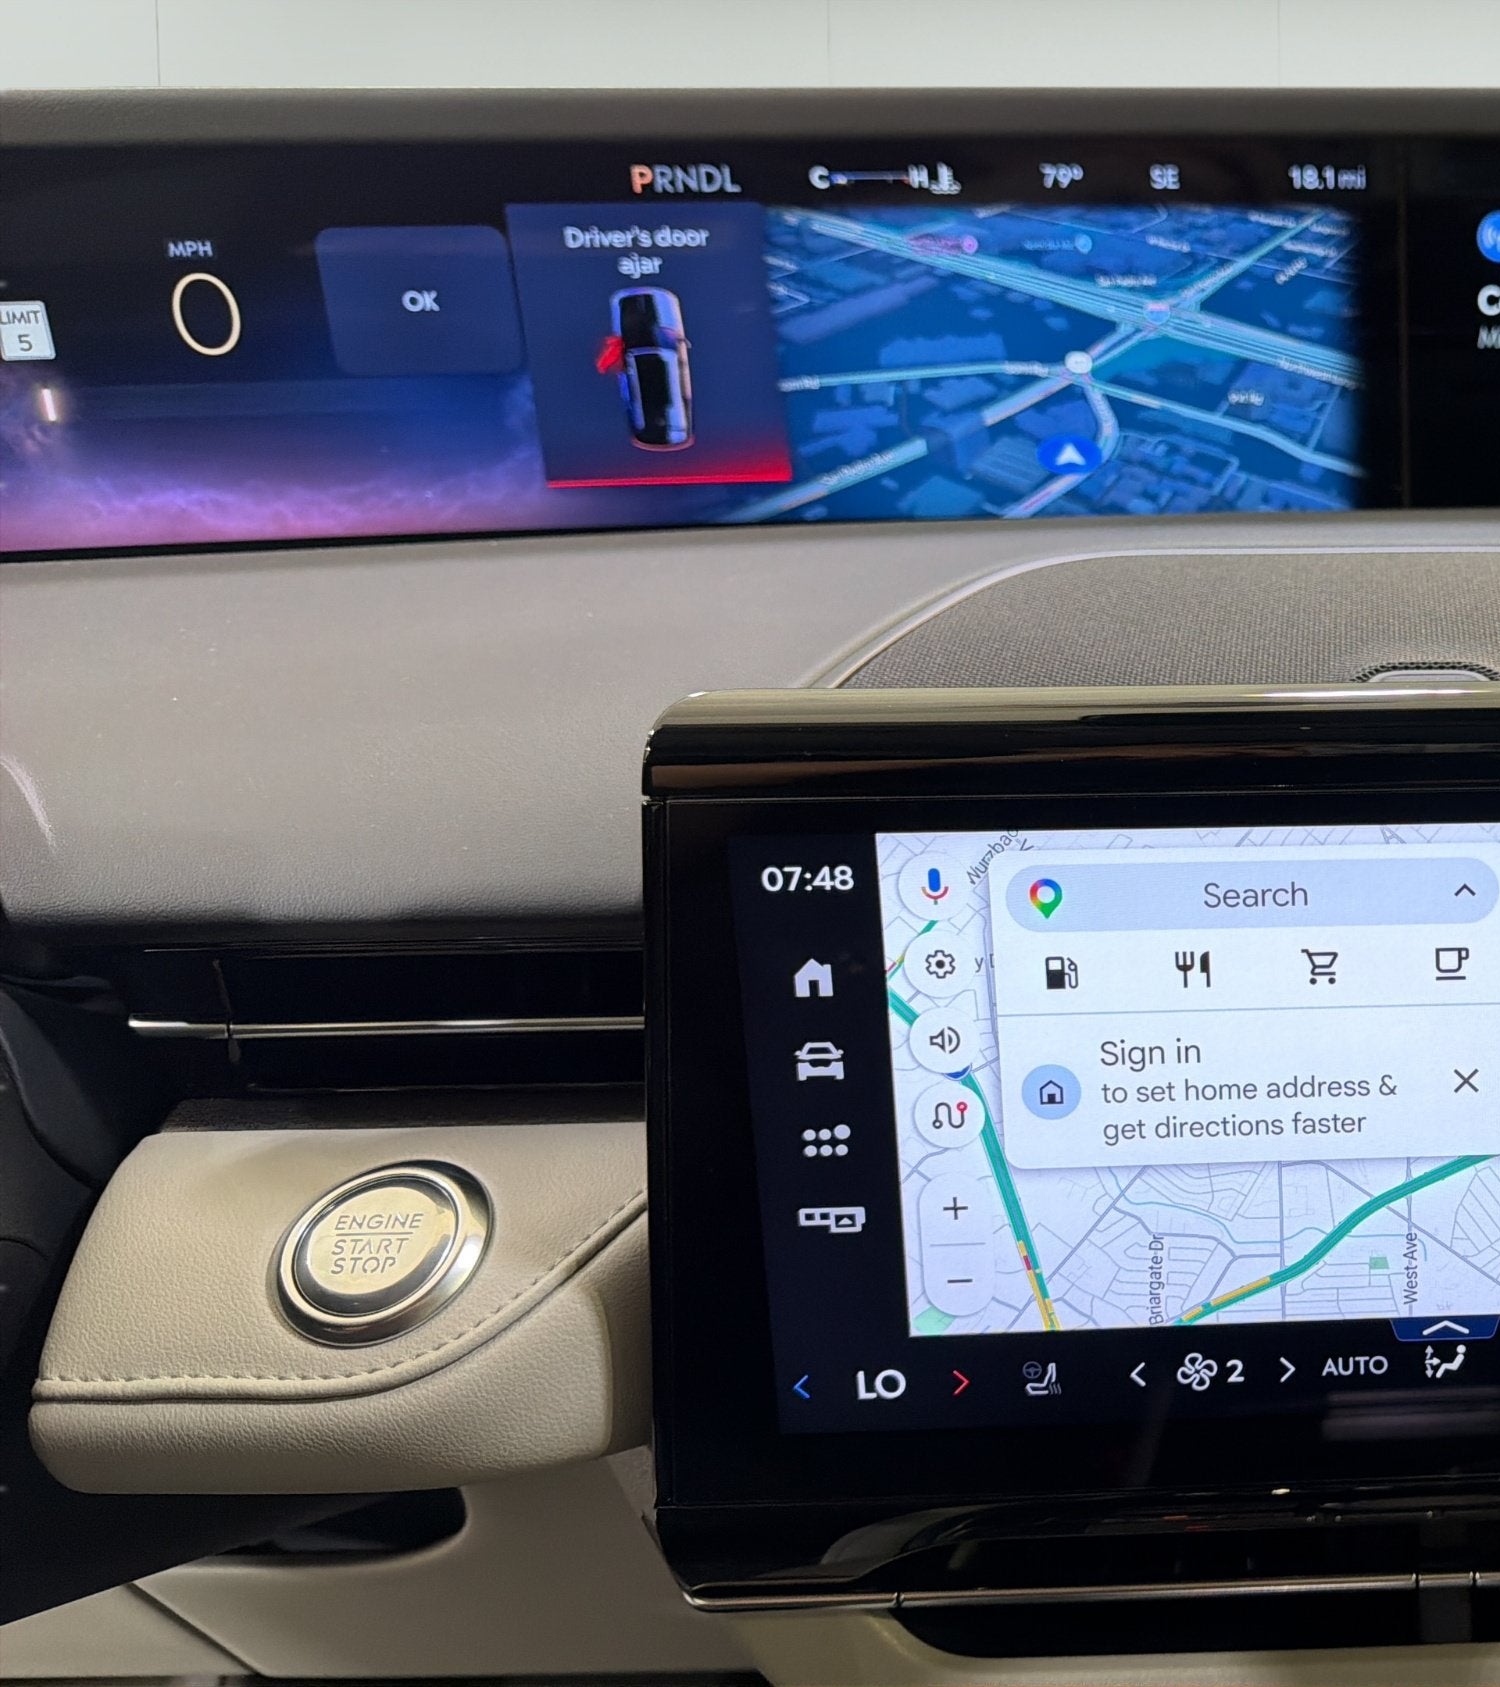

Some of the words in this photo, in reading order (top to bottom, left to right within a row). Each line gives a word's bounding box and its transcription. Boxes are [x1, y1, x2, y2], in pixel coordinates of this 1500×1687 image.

[630, 164, 742, 193] PRNDL
[808, 165, 831, 189] C
[1039, 162, 1084, 189] 79°
[1149, 164, 1181, 190] SE
[1288, 164, 1335, 190] 18.1
[1336, 165, 1368, 190] mi
[168, 242, 214, 258] MPH
[563, 225, 653, 250] Driver's
[653, 225, 709, 248] door
[617, 253, 663, 279] ajar
[172, 272, 241, 357] 0
[402, 291, 441, 314] OK
[0, 309, 41, 326] LIMIT
[17, 333, 33, 352] 5
[761, 865, 855, 892] 07:48
[1202, 880, 1309, 909] Search
[1099, 1038, 1166, 1072] Sign
[1175, 1037, 1203, 1065] in
[1101, 1081, 1129, 1105] to
[1135, 1080, 1176, 1103] set
[1183, 1077, 1259, 1102] home
[1266, 1074, 1372, 1101] address
[1378, 1073, 1399, 1098] &
[1102, 1121, 1147, 1147] get
[1153, 1114, 1285, 1140] directions
[1291, 1111, 1368, 1134] faster
[334, 1212, 424, 1231] ENGINE
[331, 1237, 410, 1256] START
[1149, 1233, 1164, 1256] Dr
[1403, 1231, 1419, 1262] Ave
[330, 1256, 396, 1275] STOP
[1148, 1264, 1165, 1327] Briargate
[1402, 1265, 1419, 1305] West
[1226, 1359, 1245, 1383] 2
[1322, 1354, 1389, 1377] AUTO
[856, 1368, 907, 1399] LO
